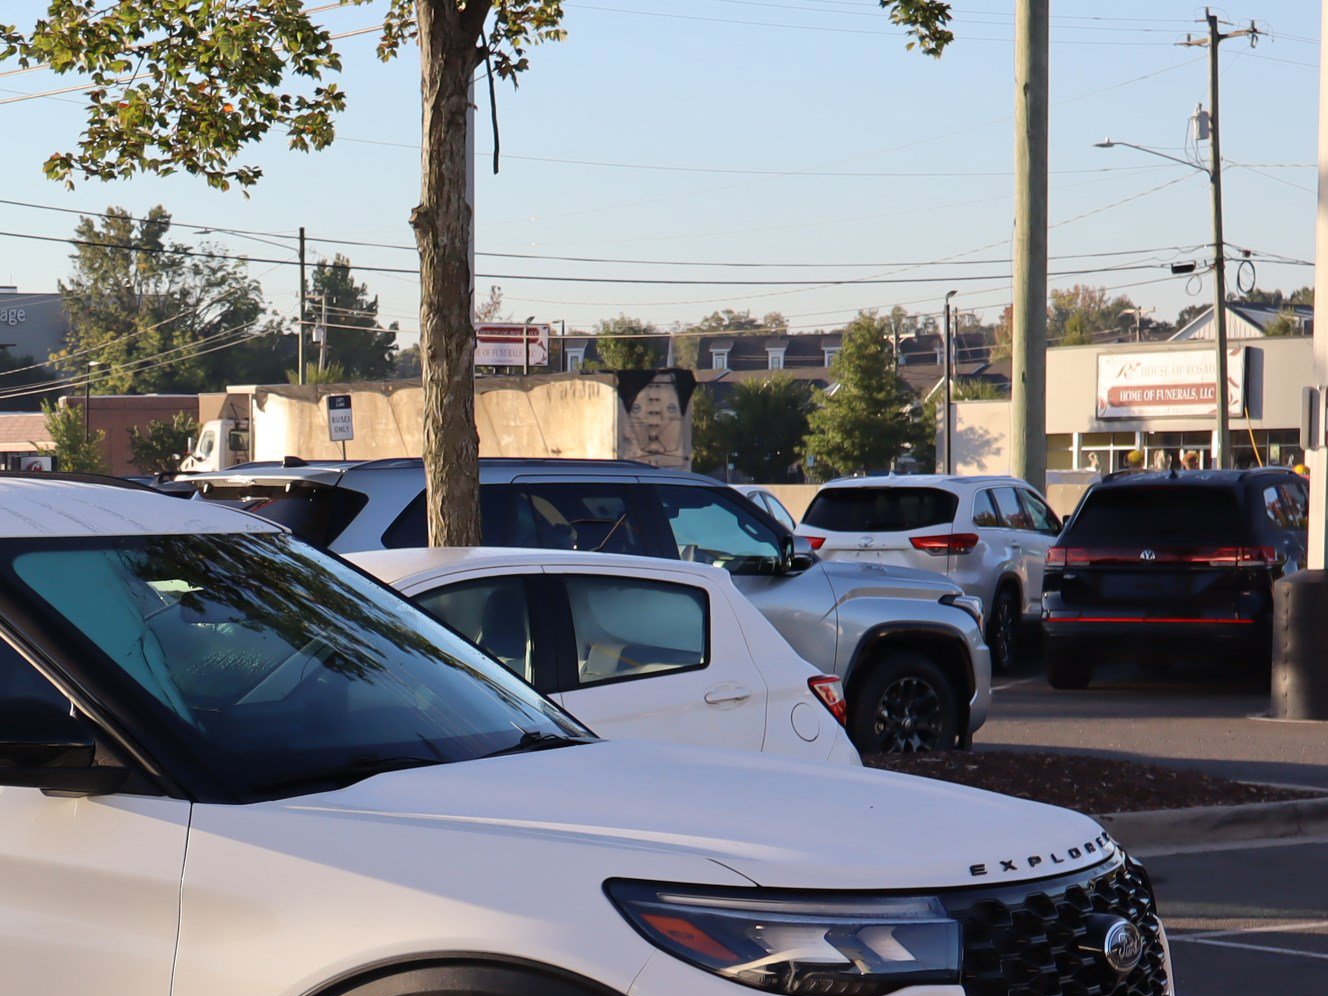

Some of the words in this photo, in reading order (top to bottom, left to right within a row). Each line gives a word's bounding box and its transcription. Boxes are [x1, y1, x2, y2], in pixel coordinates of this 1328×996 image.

[1186, 362, 1217, 375] ROSAD
[1119, 390, 1142, 402] HOME
[1143, 389, 1155, 401] OF
[1156, 388, 1198, 401] FUNERALS,
[1199, 387, 1215, 400] LLC
[332, 415, 351, 423] BUSES
